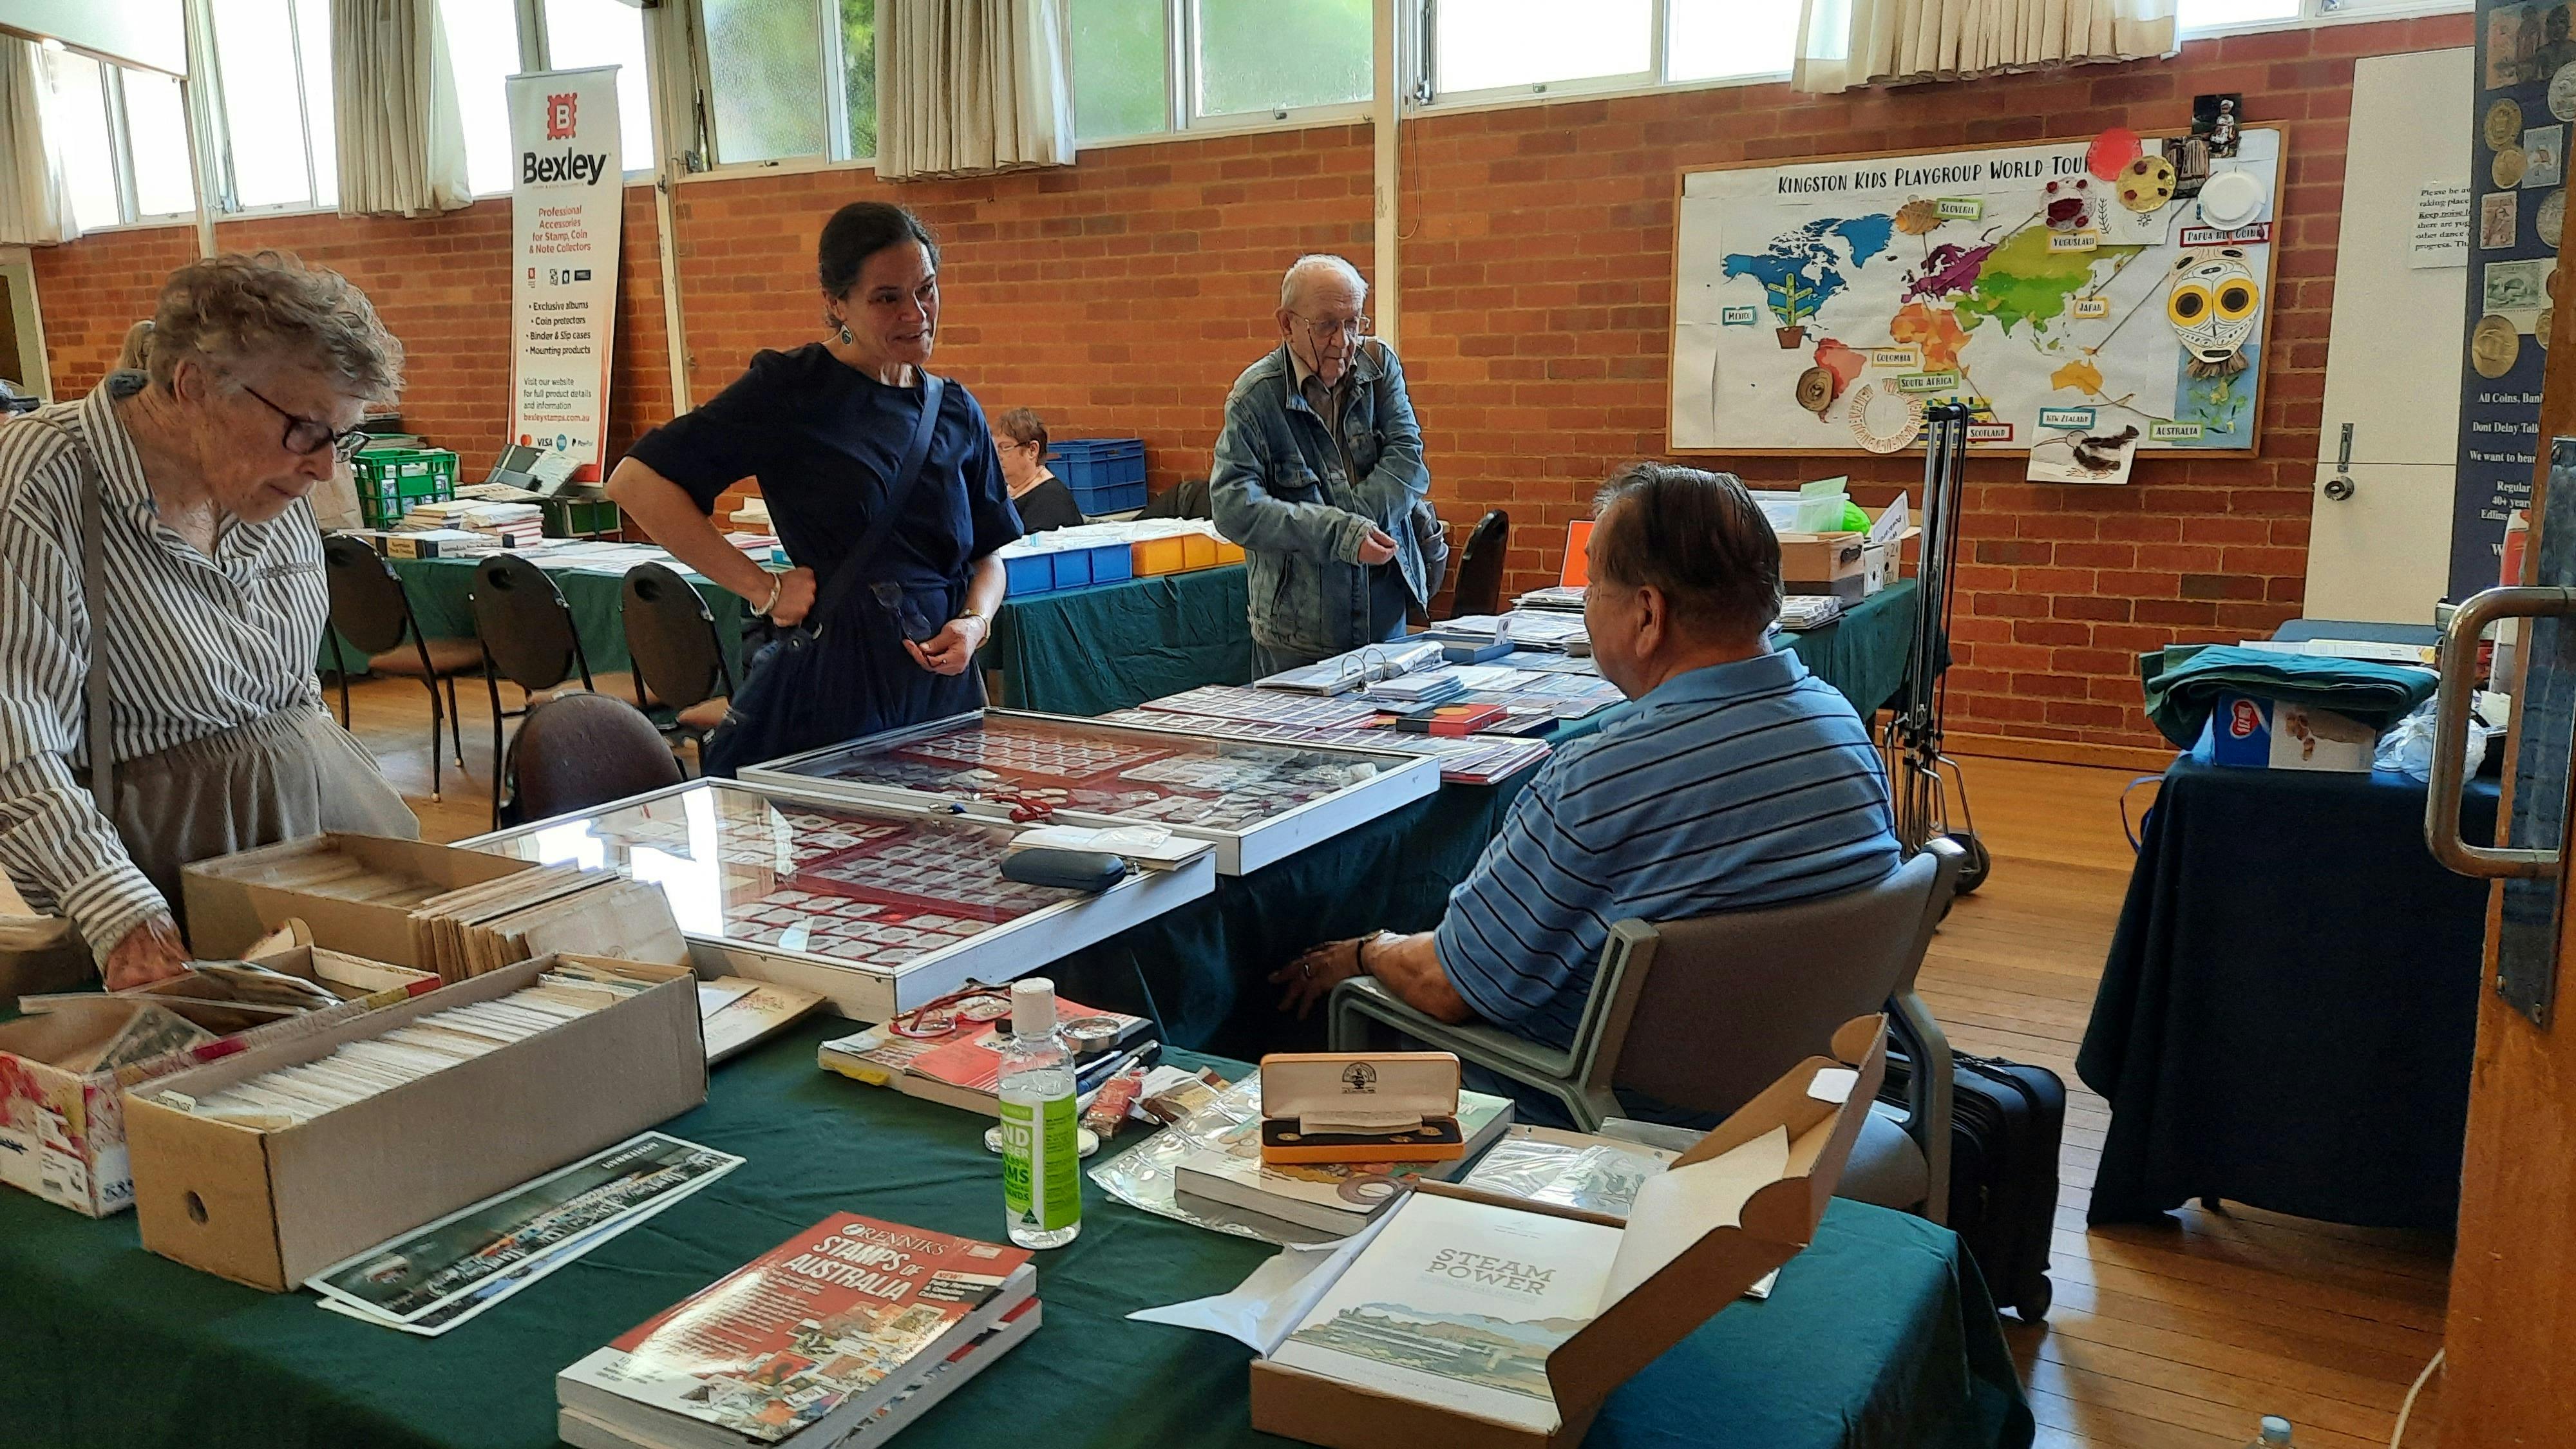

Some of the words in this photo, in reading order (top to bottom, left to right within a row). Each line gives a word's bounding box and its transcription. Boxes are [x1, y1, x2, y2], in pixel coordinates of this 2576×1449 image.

[556, 104, 570, 129] B
[523, 147, 607, 185] Bexley
[1778, 175, 1847, 194] KINGSTON
[1855, 171, 1887, 189] KIDS
[1895, 163, 1982, 187] PLAYGROUP
[1990, 158, 2043, 178] WORLD
[2447, 198, 2469, 207] place
[538, 205, 582, 217] Professional
[540, 218, 581, 229] Accessories
[533, 232, 542, 242] for
[545, 231, 570, 242] Stamp,
[571, 229, 587, 239] Coin
[529, 245, 535, 254] &
[536, 243, 554, 254] Note
[556, 242, 591, 252] Collectors
[533, 302, 564, 311] Exclusive
[565, 301, 589, 310] albums
[553, 316, 586, 327] protectors
[560, 332, 571, 341] Slip
[530, 346, 561, 356] Mounting
[562, 346, 591, 355] products
[545, 390, 569, 399] product
[2478, 393, 2490, 403] All
[2492, 393, 2521, 404] Coins,
[2473, 422, 2492, 433] Dont
[2494, 422, 2519, 435] Delay
[537, 438, 553, 447] VISA
[2470, 451, 2483, 462] We
[2484, 451, 2505, 462] want
[2506, 453, 2516, 462] to
[2497, 481, 2531, 493] Regular
[860, 1227, 949, 1255] RENNIKS
[812, 1235, 911, 1273] STAMPS
[899, 1264, 925, 1277] OF
[1435, 1248, 1557, 1282] STEAM
[781, 1253, 913, 1302] AUSTRALIA
[1425, 1261, 1546, 1295] POWER
